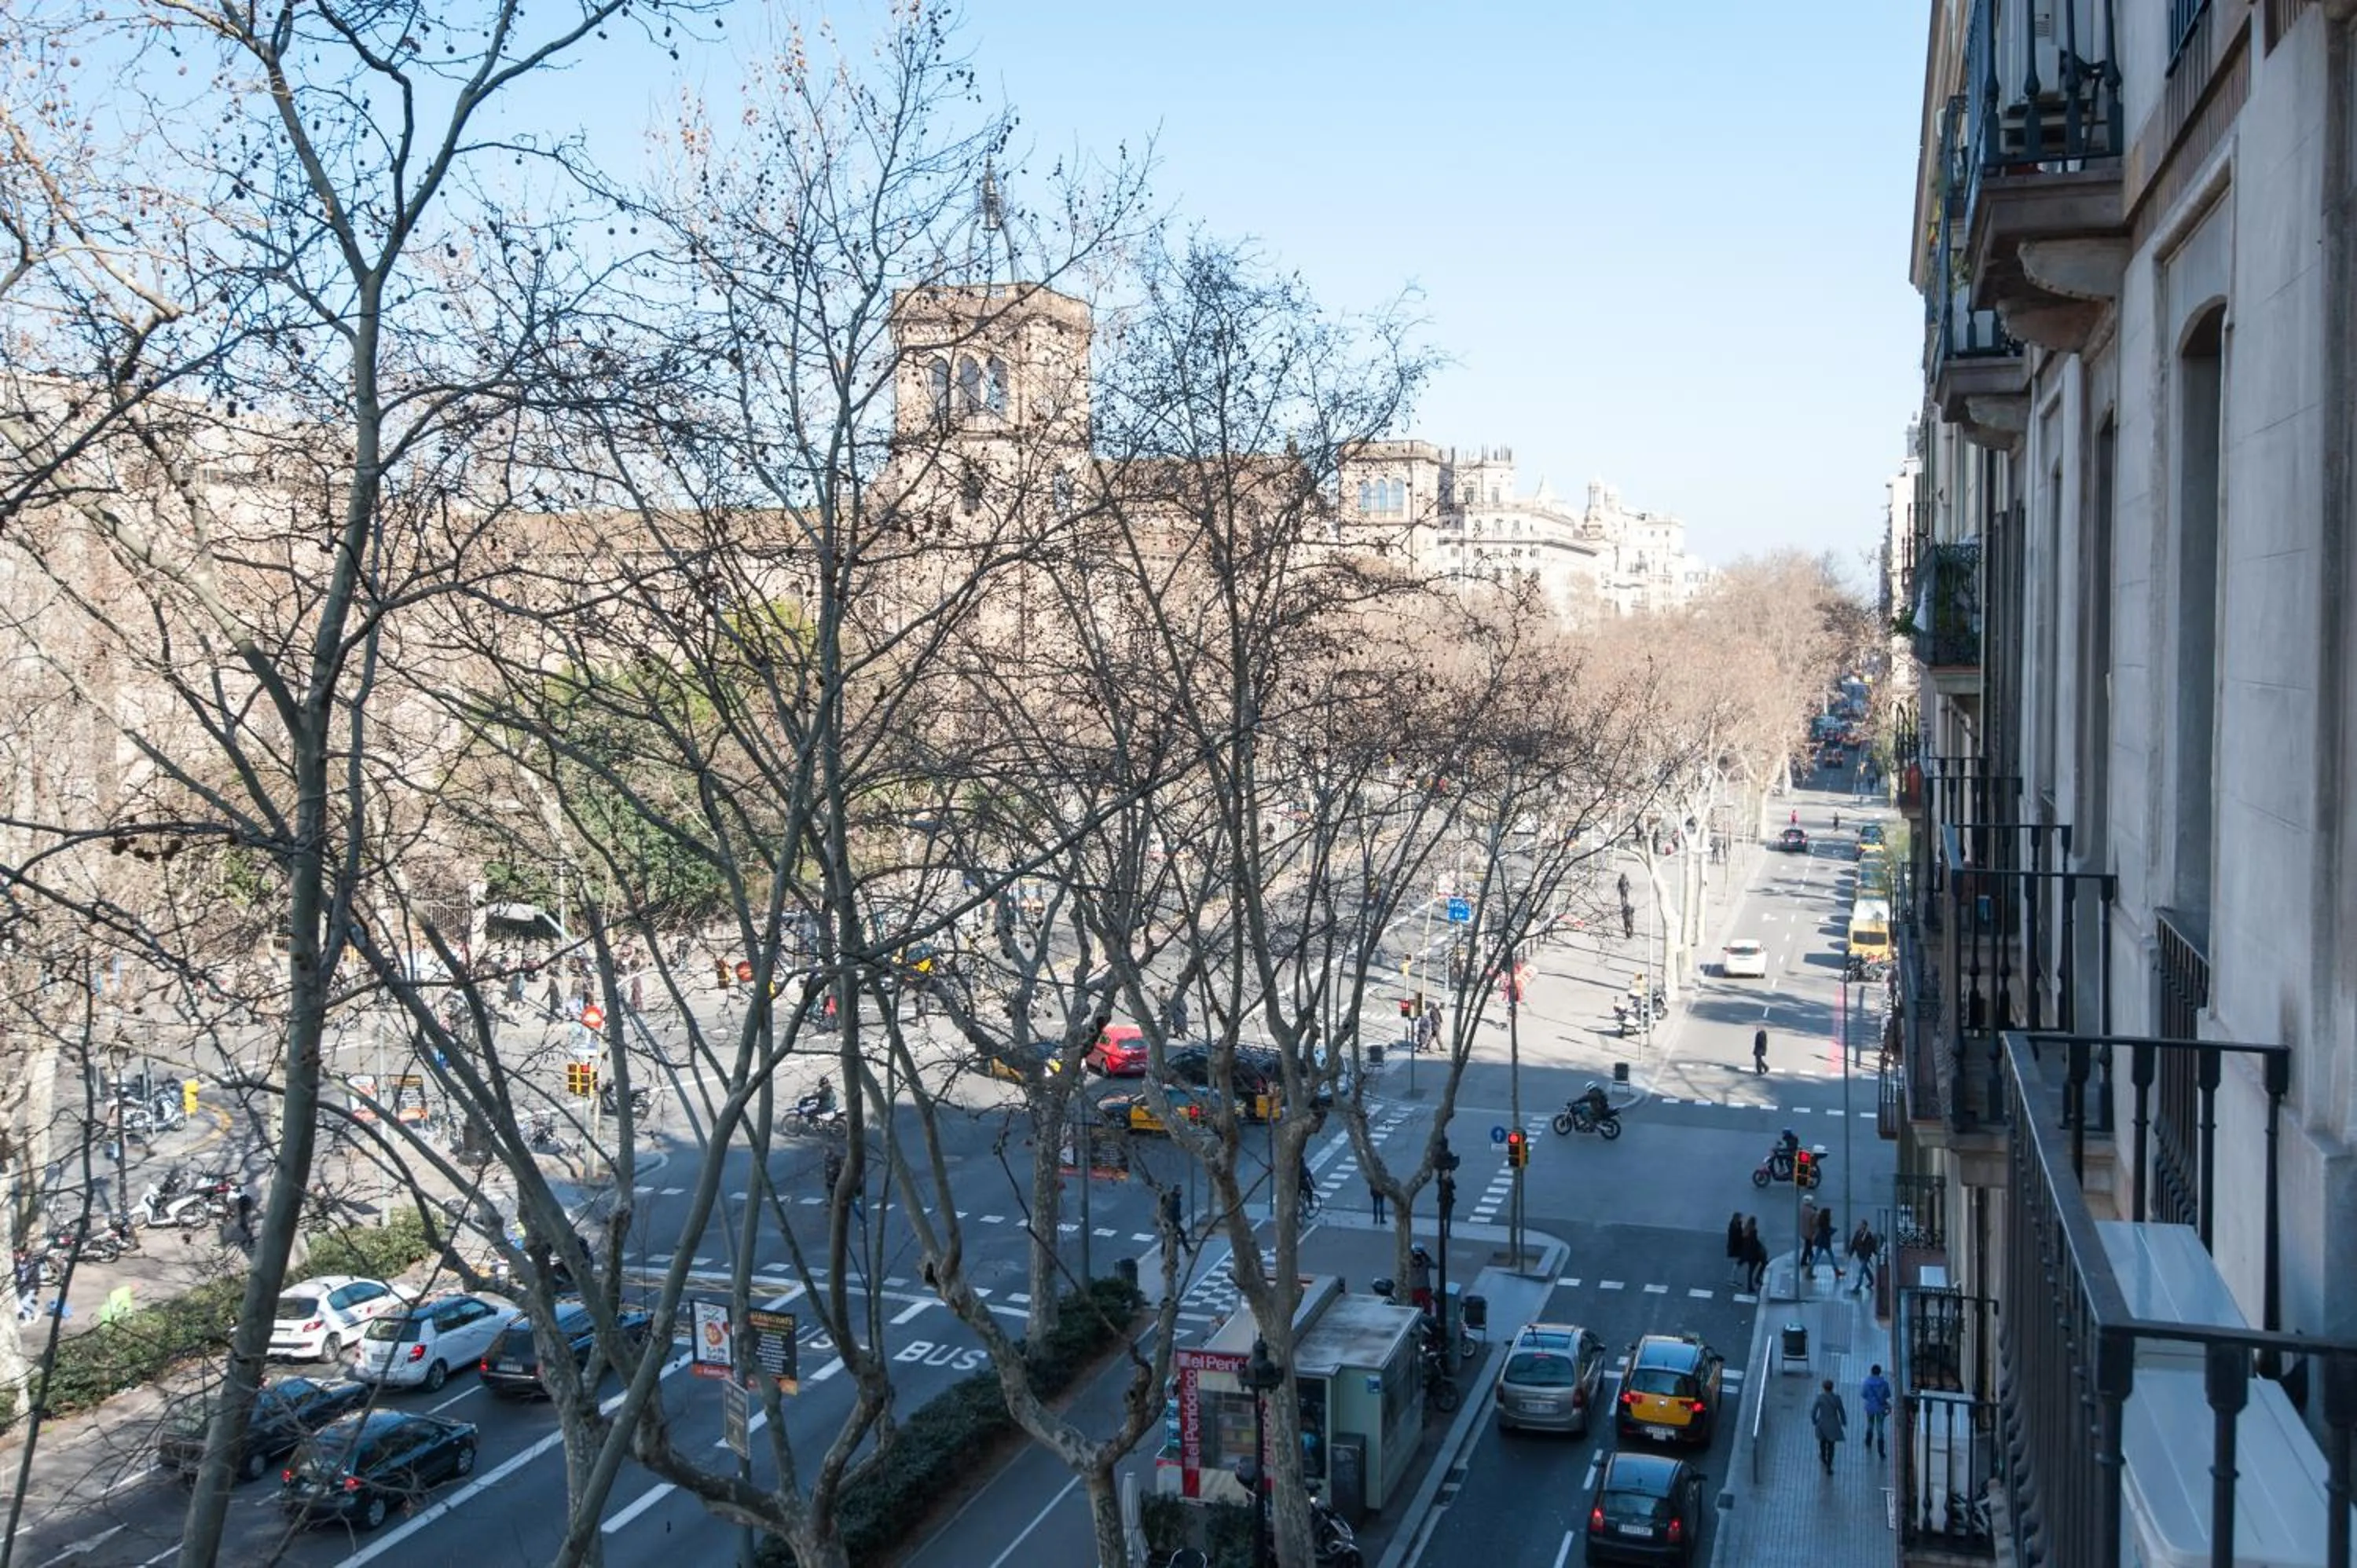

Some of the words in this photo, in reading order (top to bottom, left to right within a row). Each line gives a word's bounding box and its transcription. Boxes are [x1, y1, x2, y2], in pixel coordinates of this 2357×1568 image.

[893, 1339, 988, 1370] BUS
[1191, 1355, 1204, 1369] el
[1184, 1369, 1198, 1442] Periódico
